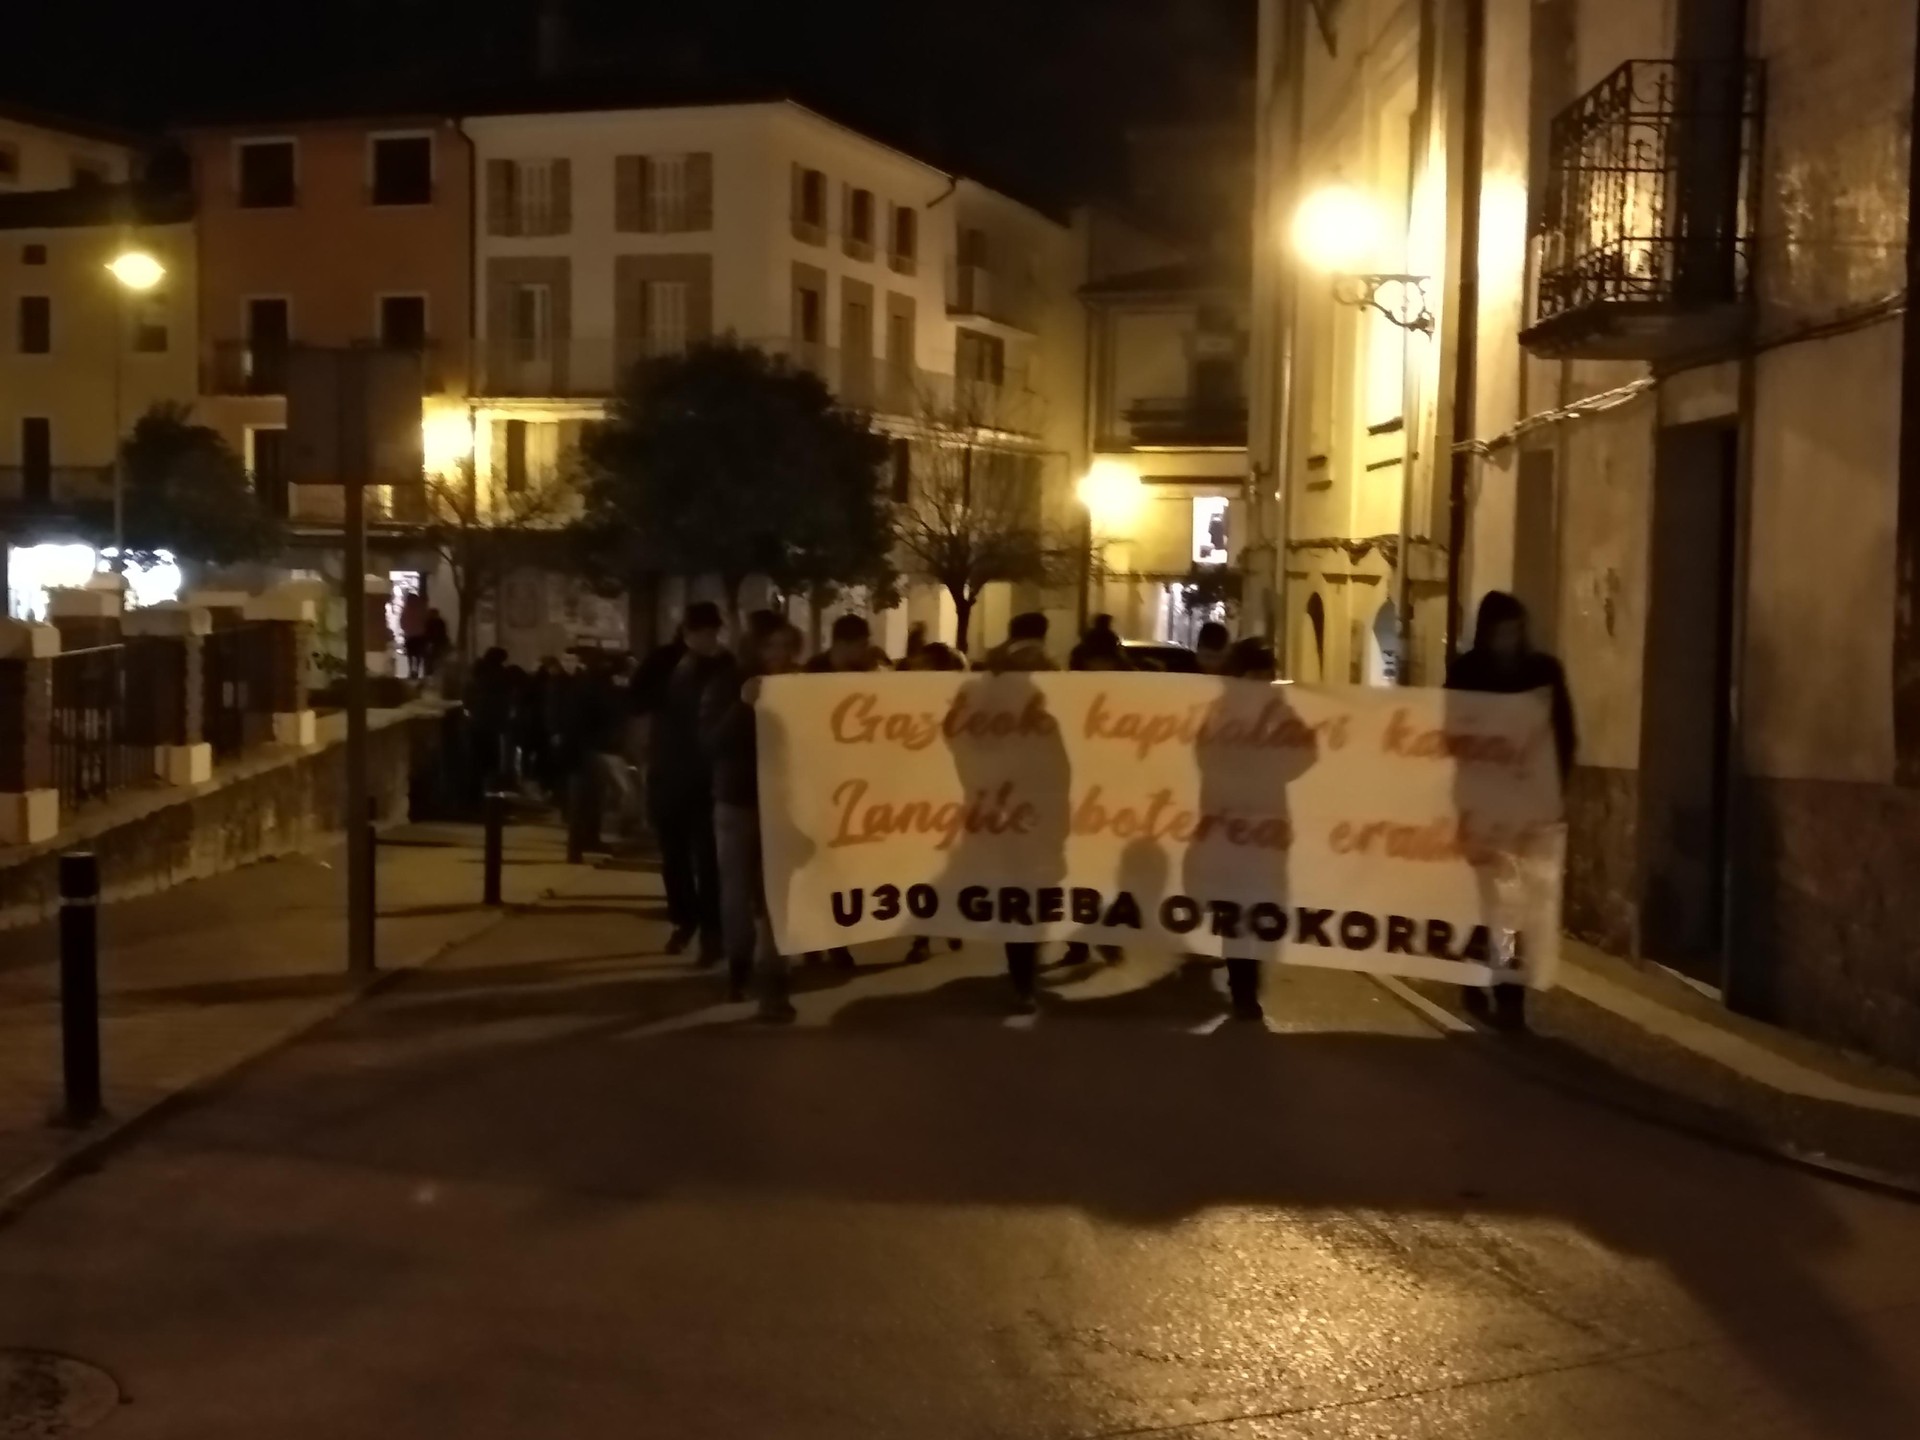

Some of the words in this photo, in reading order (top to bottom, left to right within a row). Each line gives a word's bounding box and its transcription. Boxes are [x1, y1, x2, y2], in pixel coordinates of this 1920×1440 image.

[827, 778, 1038, 850] Langile
[1073, 785, 1290, 851] boterea
[830, 883, 939, 927] U30
[957, 884, 1142, 929] GREBA
